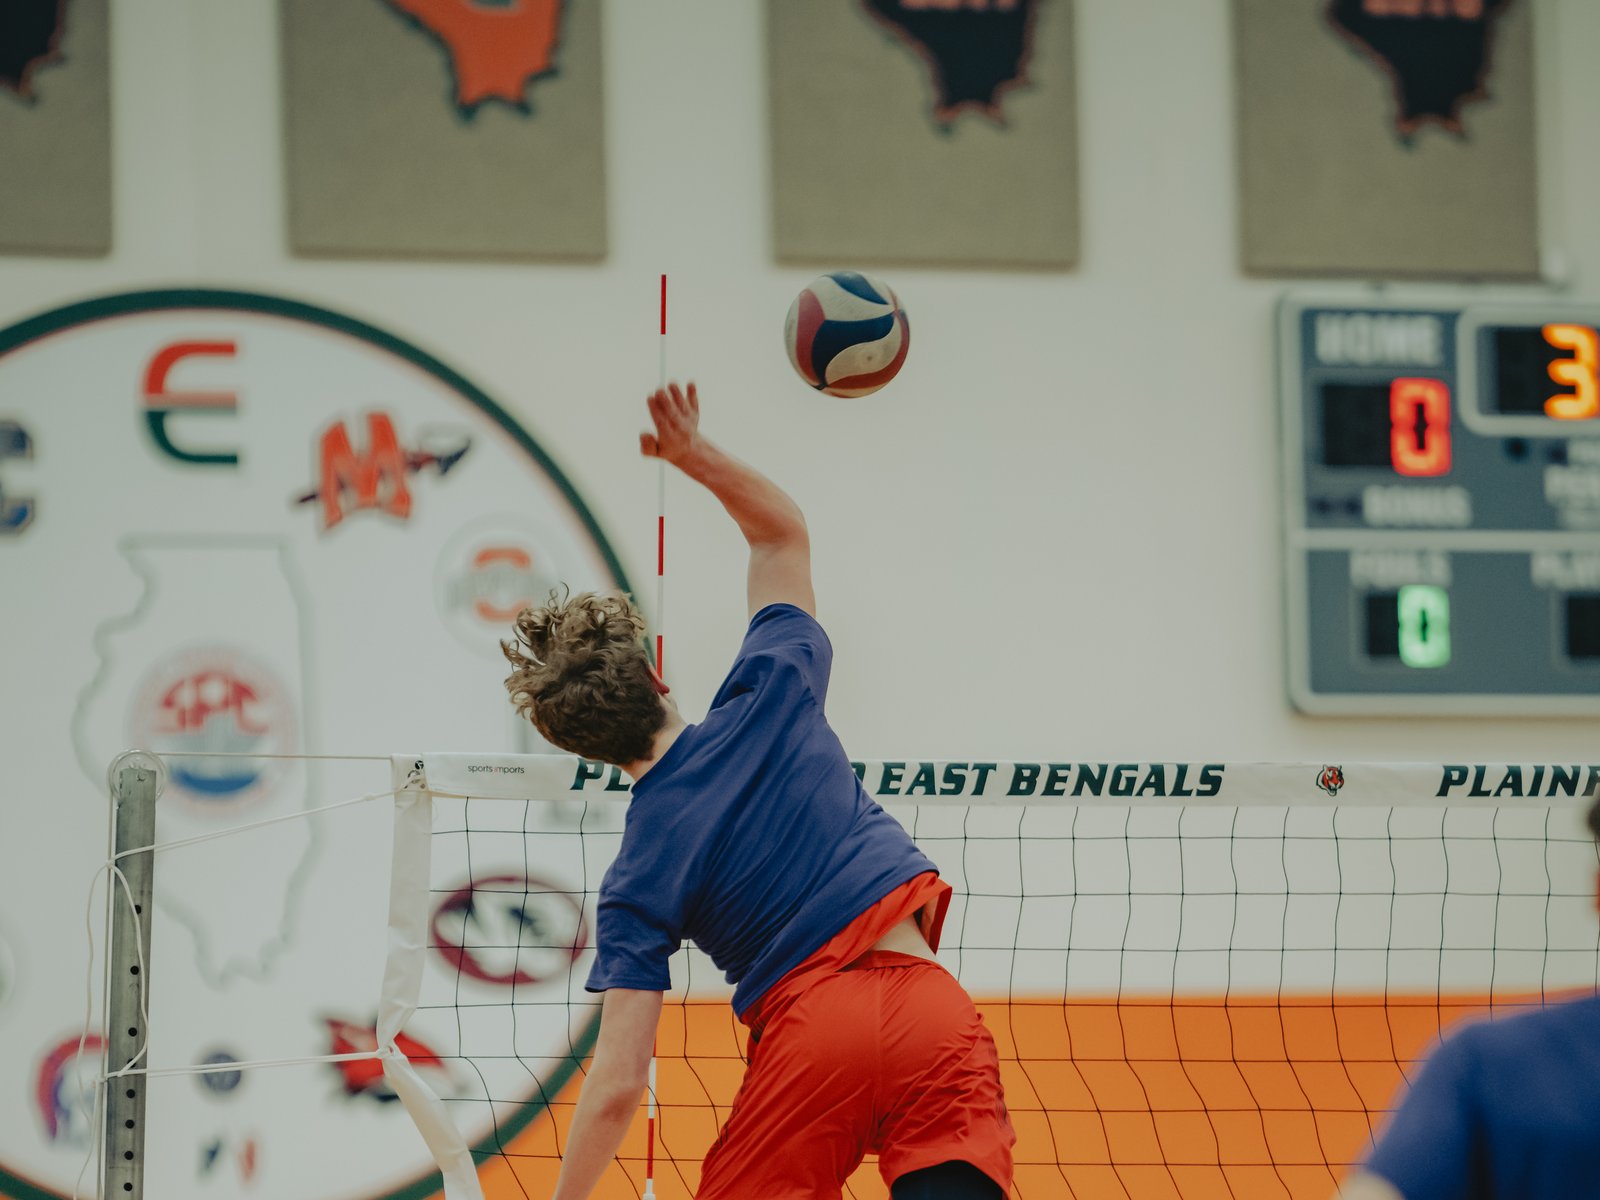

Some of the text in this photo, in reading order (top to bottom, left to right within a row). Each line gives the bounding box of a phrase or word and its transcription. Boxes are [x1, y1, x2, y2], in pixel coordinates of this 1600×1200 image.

[1390, 377, 1452, 477] 0
[1397, 584, 1451, 669] 0
[876, 762, 997, 796] EAST
[1006, 763, 1225, 797] BENGALS
